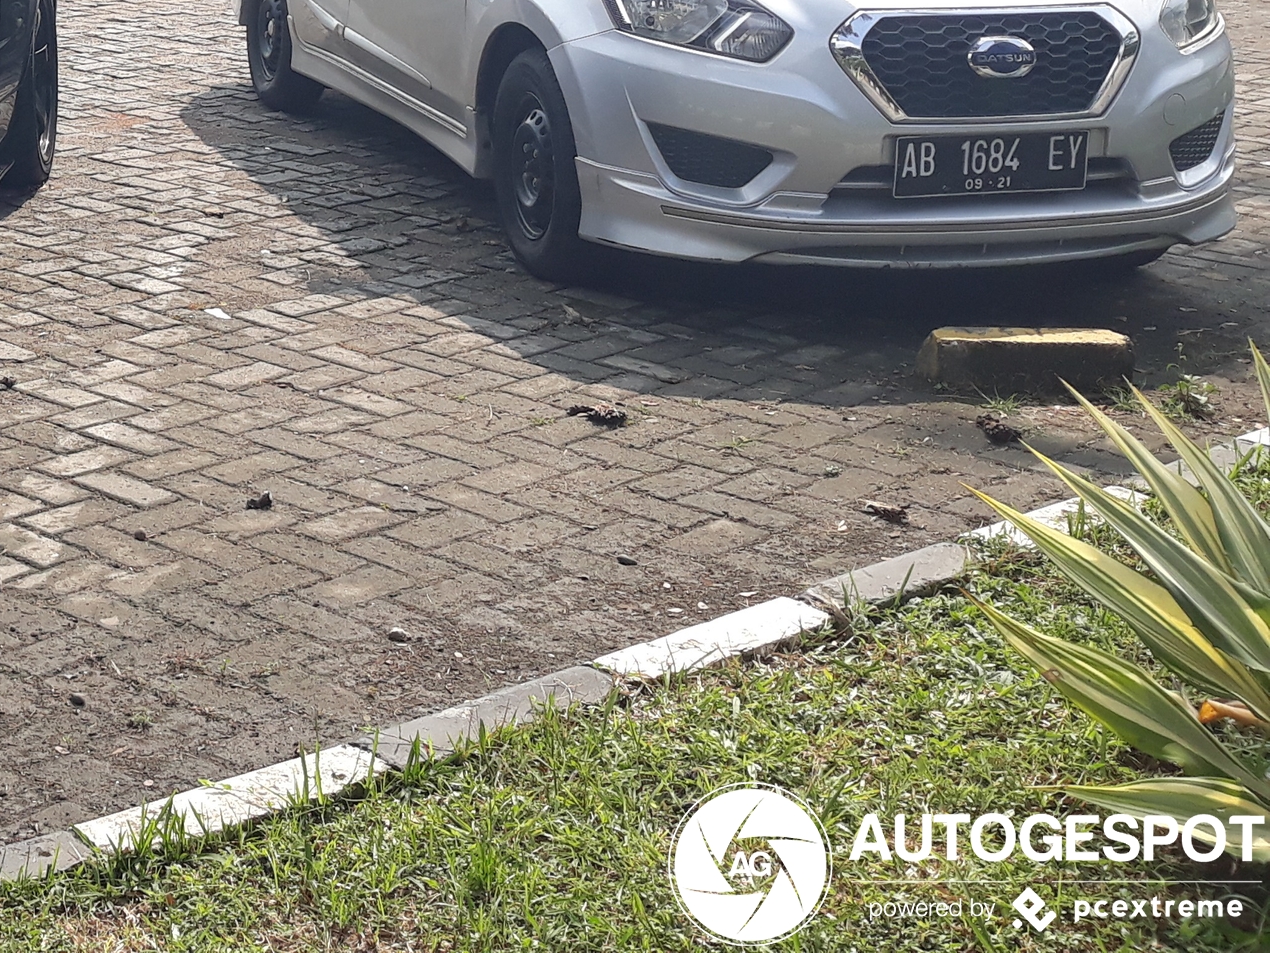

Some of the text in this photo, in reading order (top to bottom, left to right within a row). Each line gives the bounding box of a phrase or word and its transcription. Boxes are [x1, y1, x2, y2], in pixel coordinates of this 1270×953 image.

[978, 54, 1031, 63] DATSUN
[901, 135, 1083, 178] AB 1684 EY
